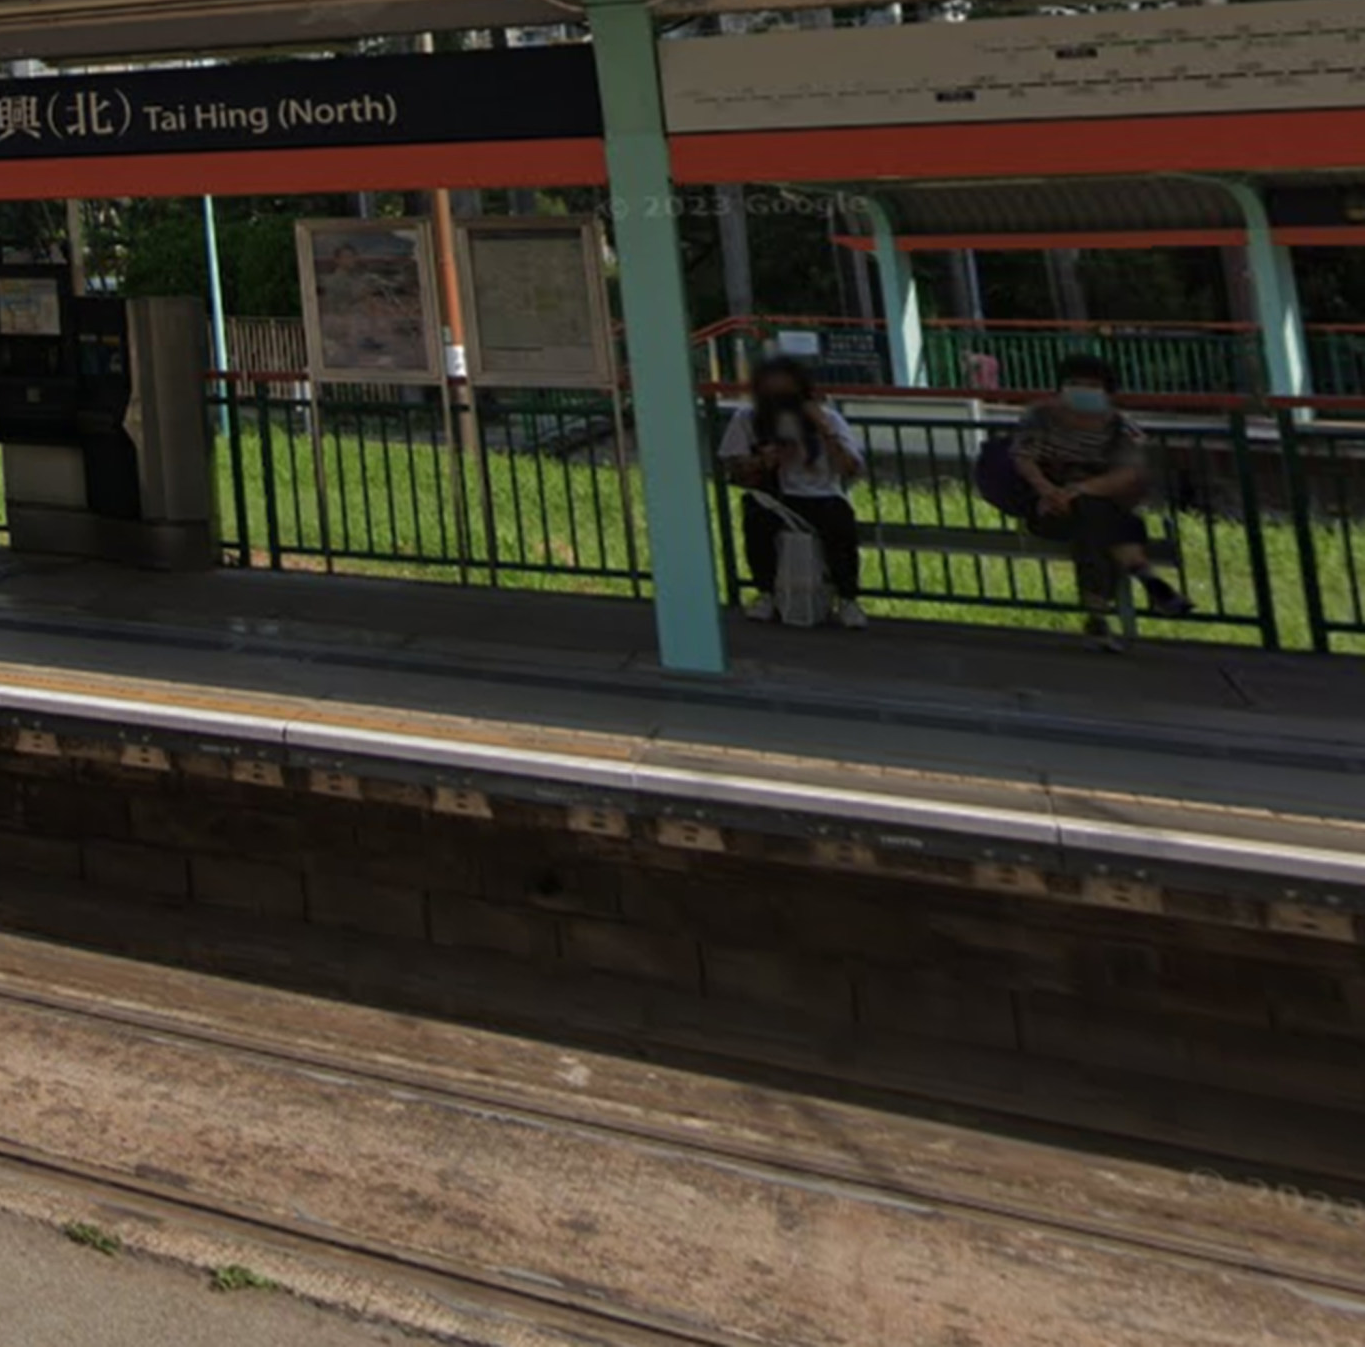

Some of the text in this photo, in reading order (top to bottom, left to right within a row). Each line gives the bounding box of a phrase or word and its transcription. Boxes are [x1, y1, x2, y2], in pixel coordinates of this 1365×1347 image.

[142, 104, 187, 132] Tai
[195, 102, 268, 135] Hing
[277, 93, 397, 130] (North)
